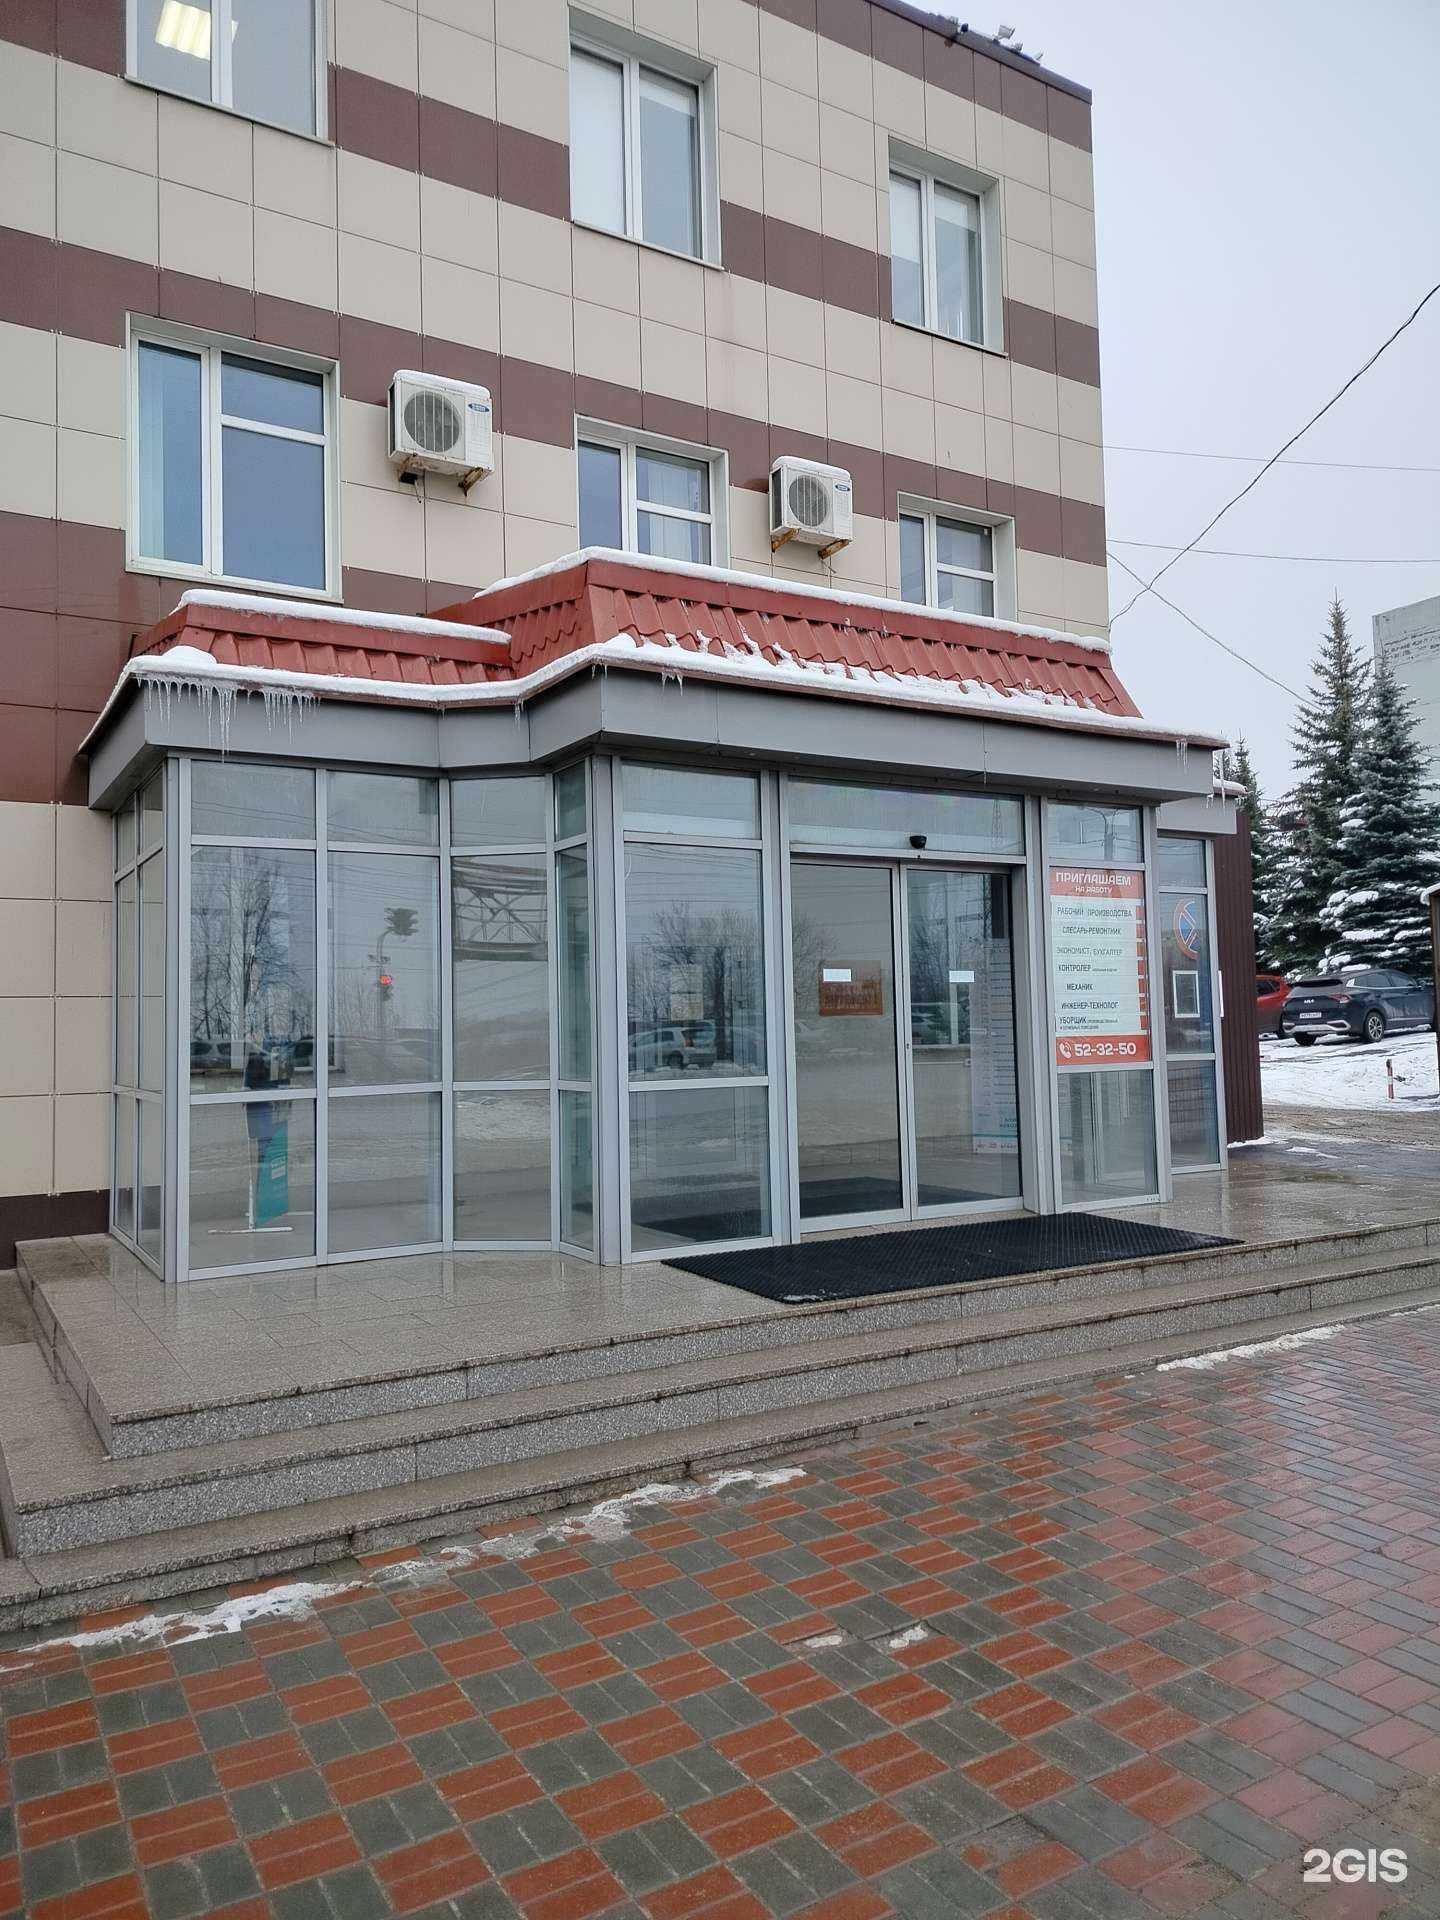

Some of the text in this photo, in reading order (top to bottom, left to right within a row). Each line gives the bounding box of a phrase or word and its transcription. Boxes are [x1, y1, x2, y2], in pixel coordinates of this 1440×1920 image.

[1056, 872, 1131, 886] ПРИГЛАШАЕМ
[1086, 886, 1113, 894] РАБОТУ
[1087, 908, 1132, 918] ПРОИЗВОДСТВА
[1066, 983, 1093, 991] МЕХАНИК
[1061, 1001, 1119, 1010] ИНЖЕНЕР-ТЕХНОЛОГ
[1060, 1016, 1087, 1025] УБОРЩИК
[1074, 1042, 1137, 1057] 52-32-50
